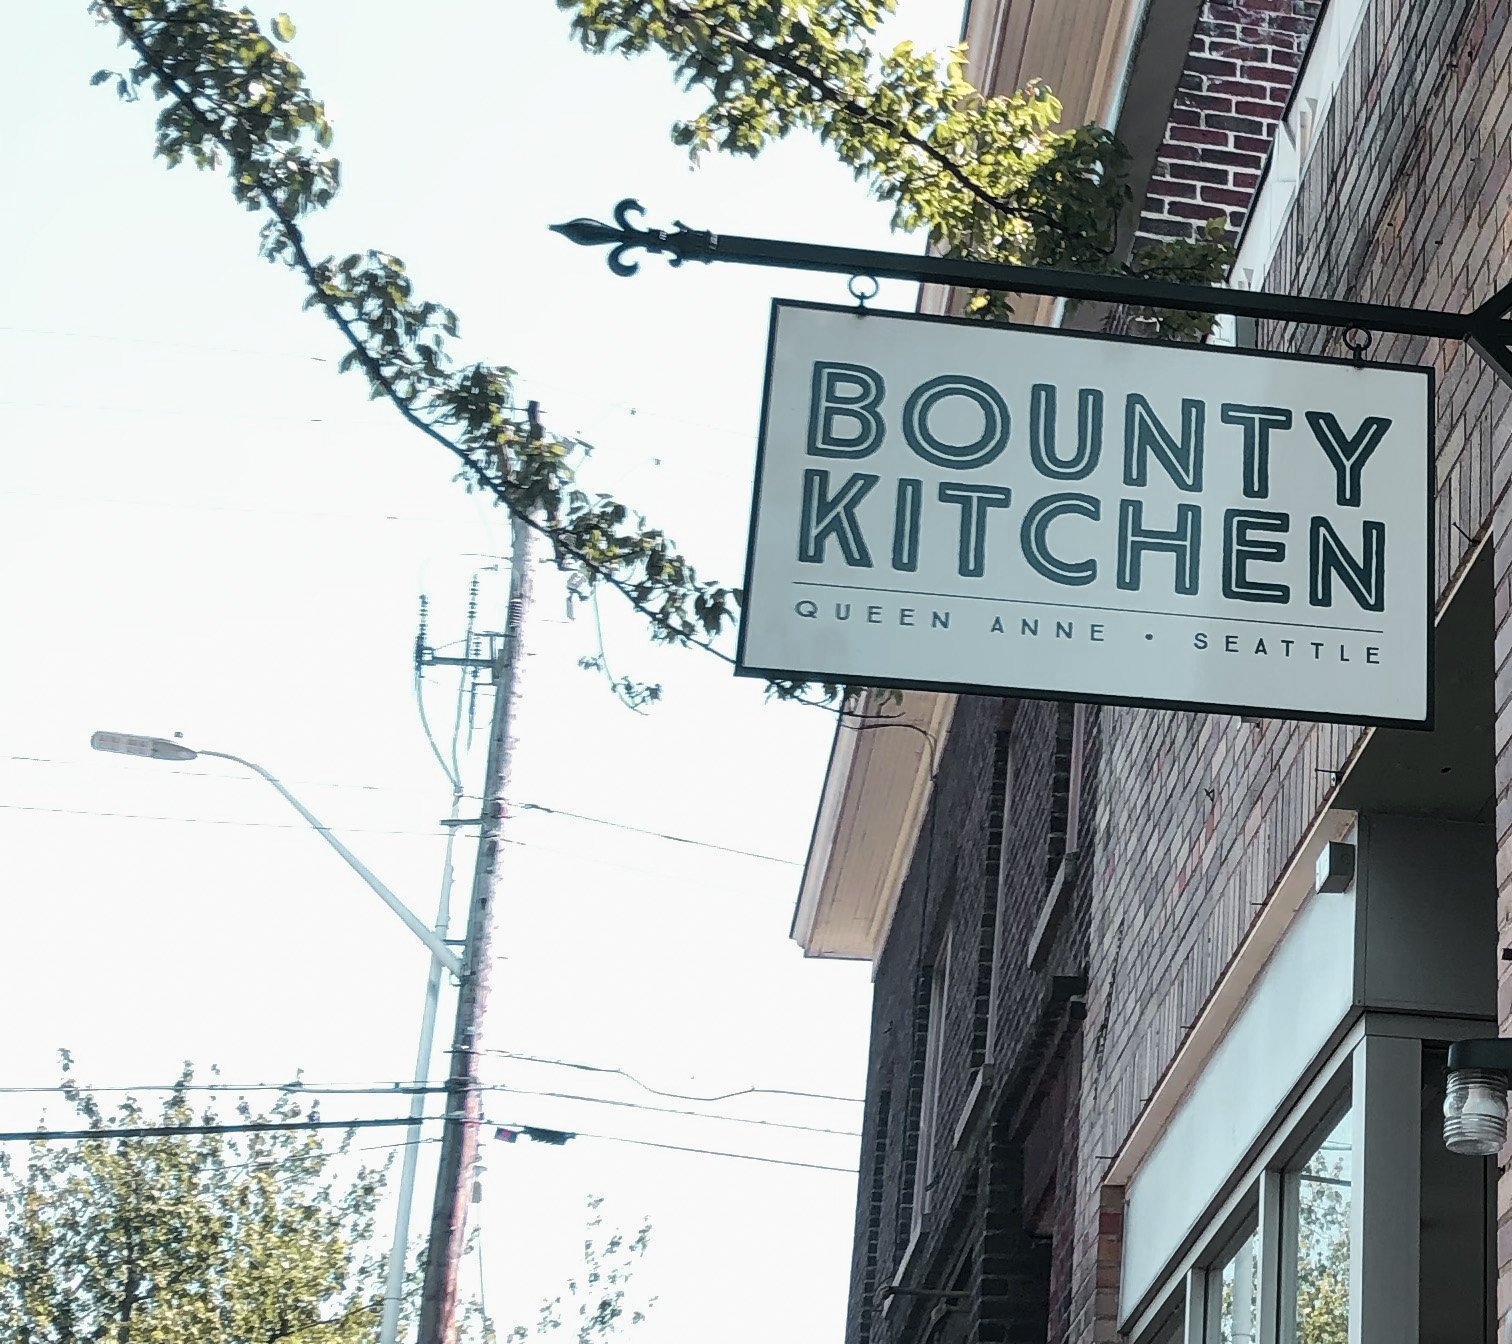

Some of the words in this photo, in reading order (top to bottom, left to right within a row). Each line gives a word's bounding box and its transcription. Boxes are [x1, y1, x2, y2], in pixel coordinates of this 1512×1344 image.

[804, 360, 1393, 508] BOUNTY
[797, 469, 1386, 613] KITCHEN
[794, 600, 952, 631] QUEEN
[990, 615, 1106, 643] ANNE
[1193, 631, 1382, 665] SEATTLE
